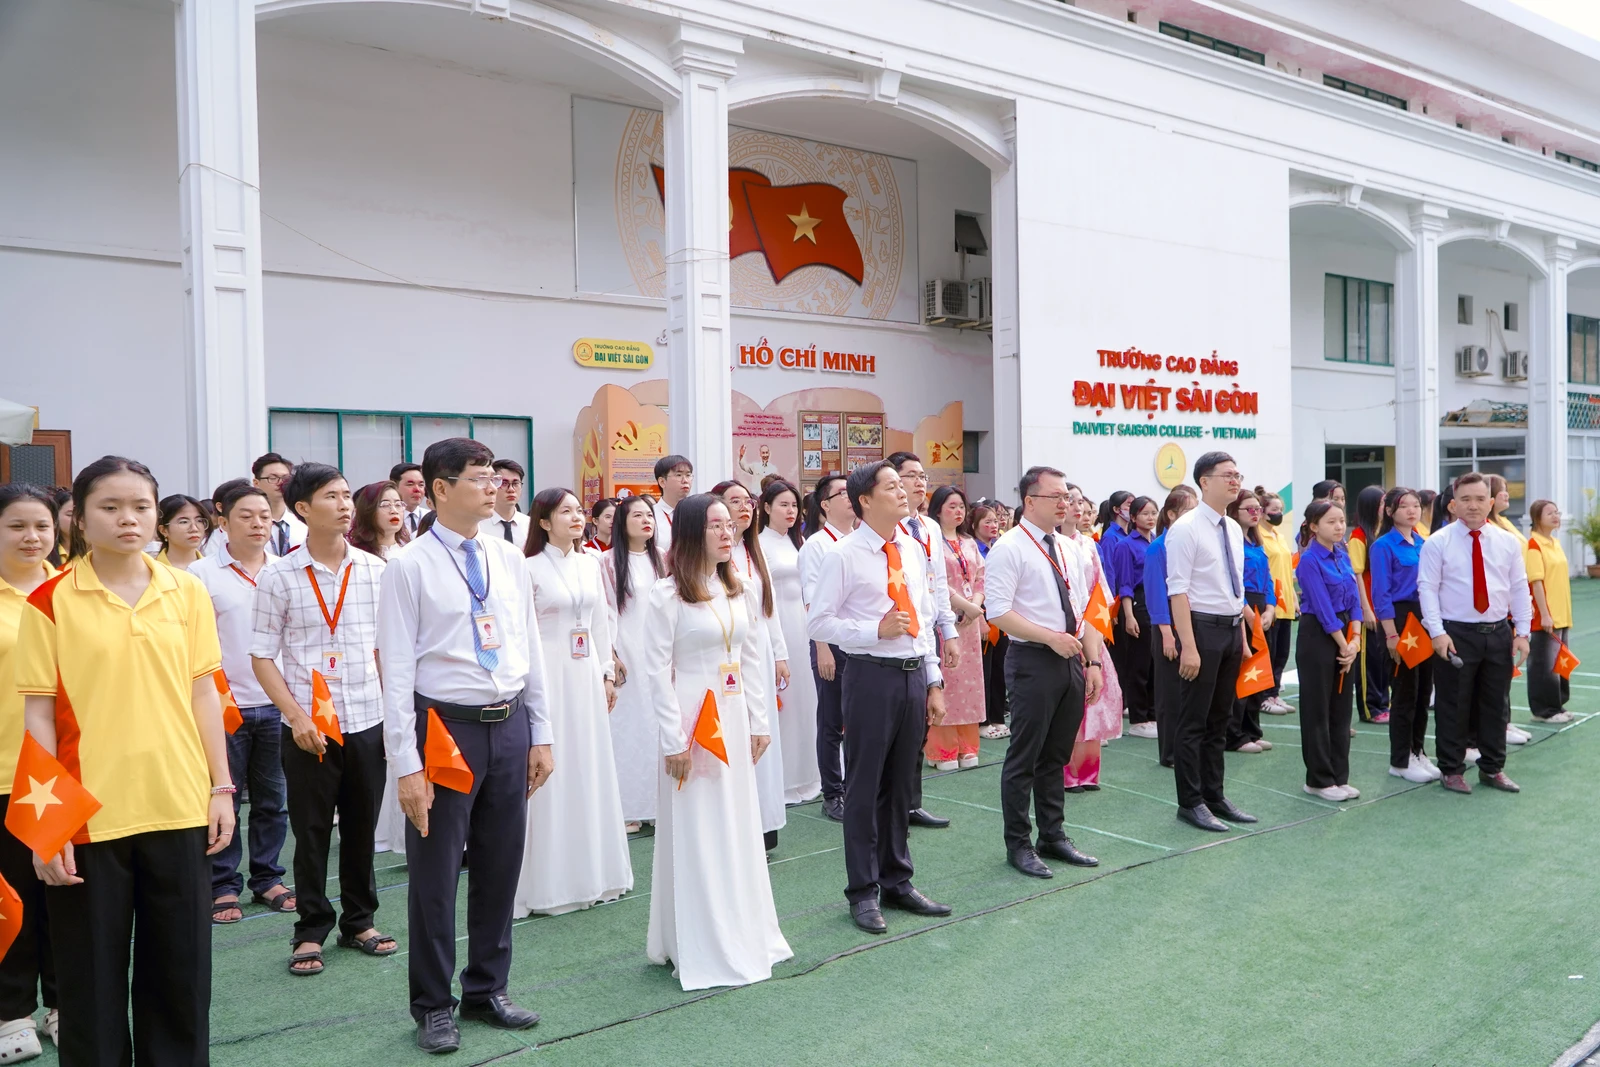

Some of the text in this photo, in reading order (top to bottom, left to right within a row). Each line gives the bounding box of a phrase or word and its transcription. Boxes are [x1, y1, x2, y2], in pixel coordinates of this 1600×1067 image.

[740, 337, 876, 373] HỒ CHÍ MINH
[1096, 346, 1239, 376] TRƯỜNG CAO ĐẲNG
[1072, 378, 1259, 420] ĐẠI VIỆT SÀI GÒN
[1117, 423, 1158, 438] SAIGON
[1158, 424, 1203, 439] COLLEGE
[1212, 426, 1257, 440] VIETNAM
